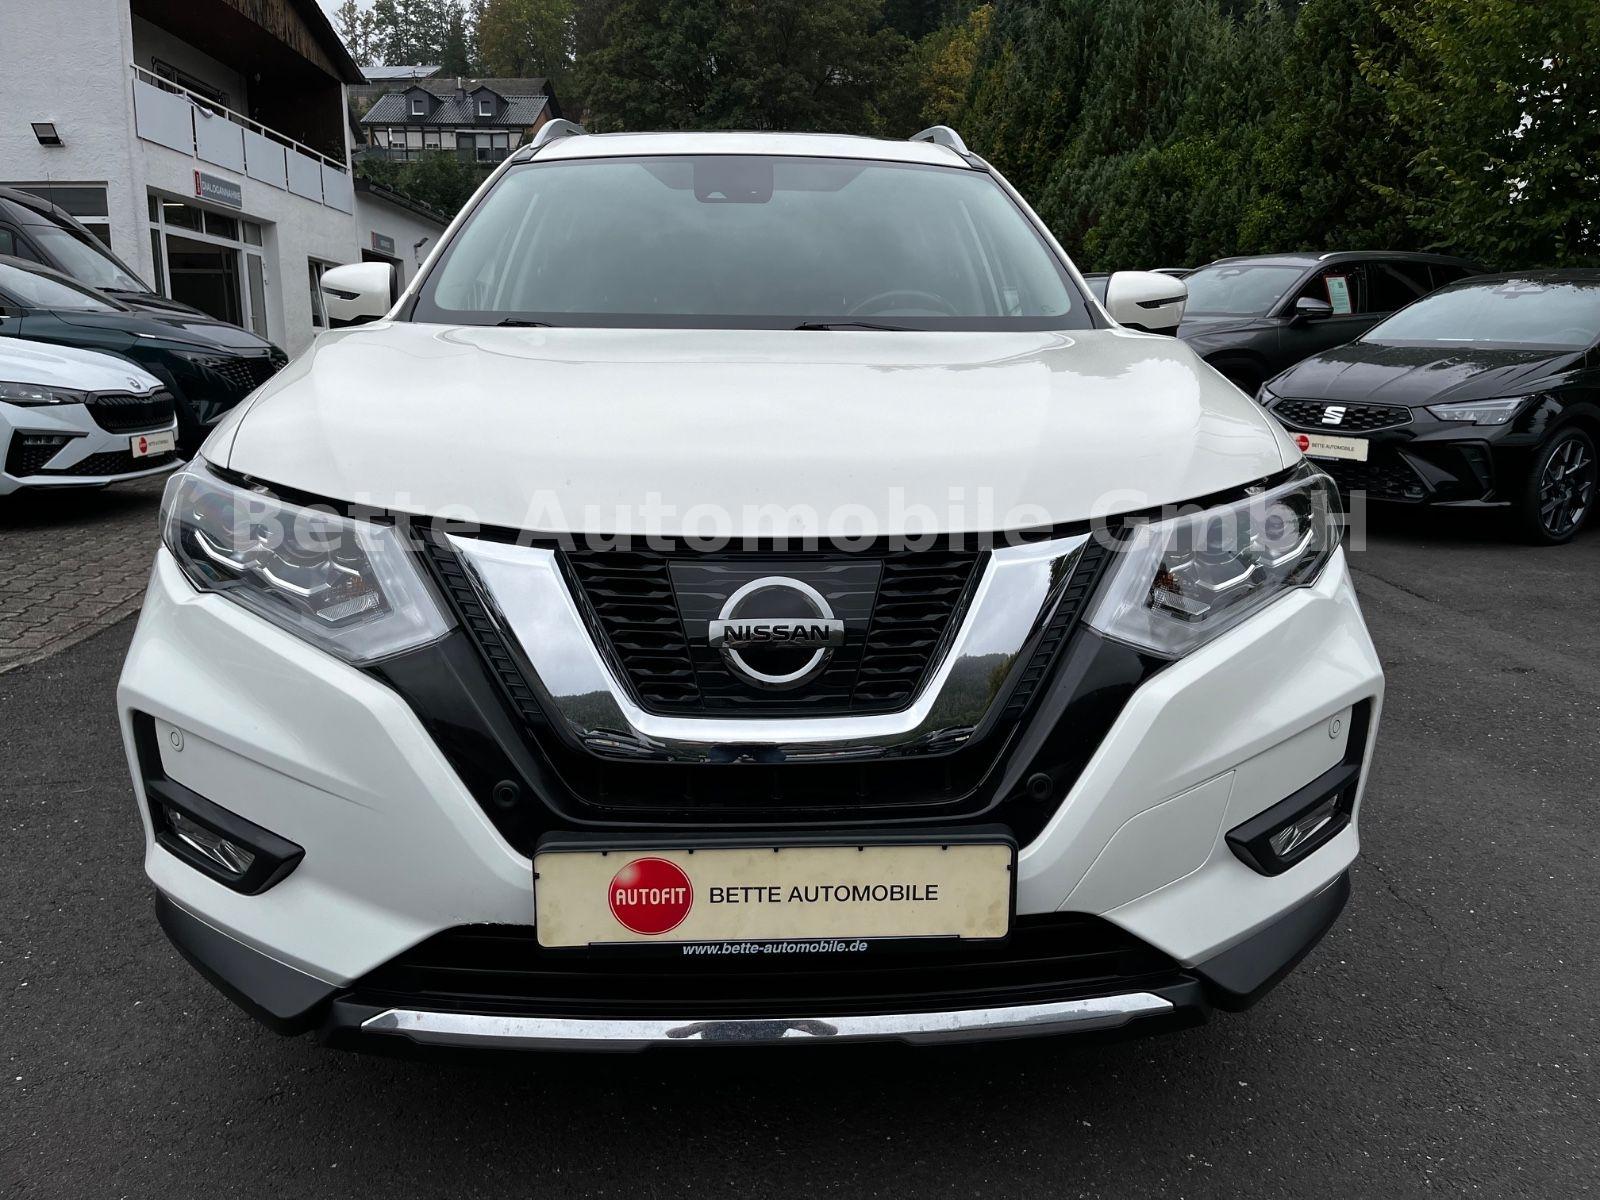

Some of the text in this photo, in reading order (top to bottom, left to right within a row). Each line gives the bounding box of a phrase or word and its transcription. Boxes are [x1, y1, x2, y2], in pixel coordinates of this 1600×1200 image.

[724, 625, 829, 641] NISSAN
[616, 888, 686, 905] AUTOFIT
[709, 884, 939, 904] BETTE AUTOMOBILE
[682, 940, 868, 956] www.bette-automobile.de
